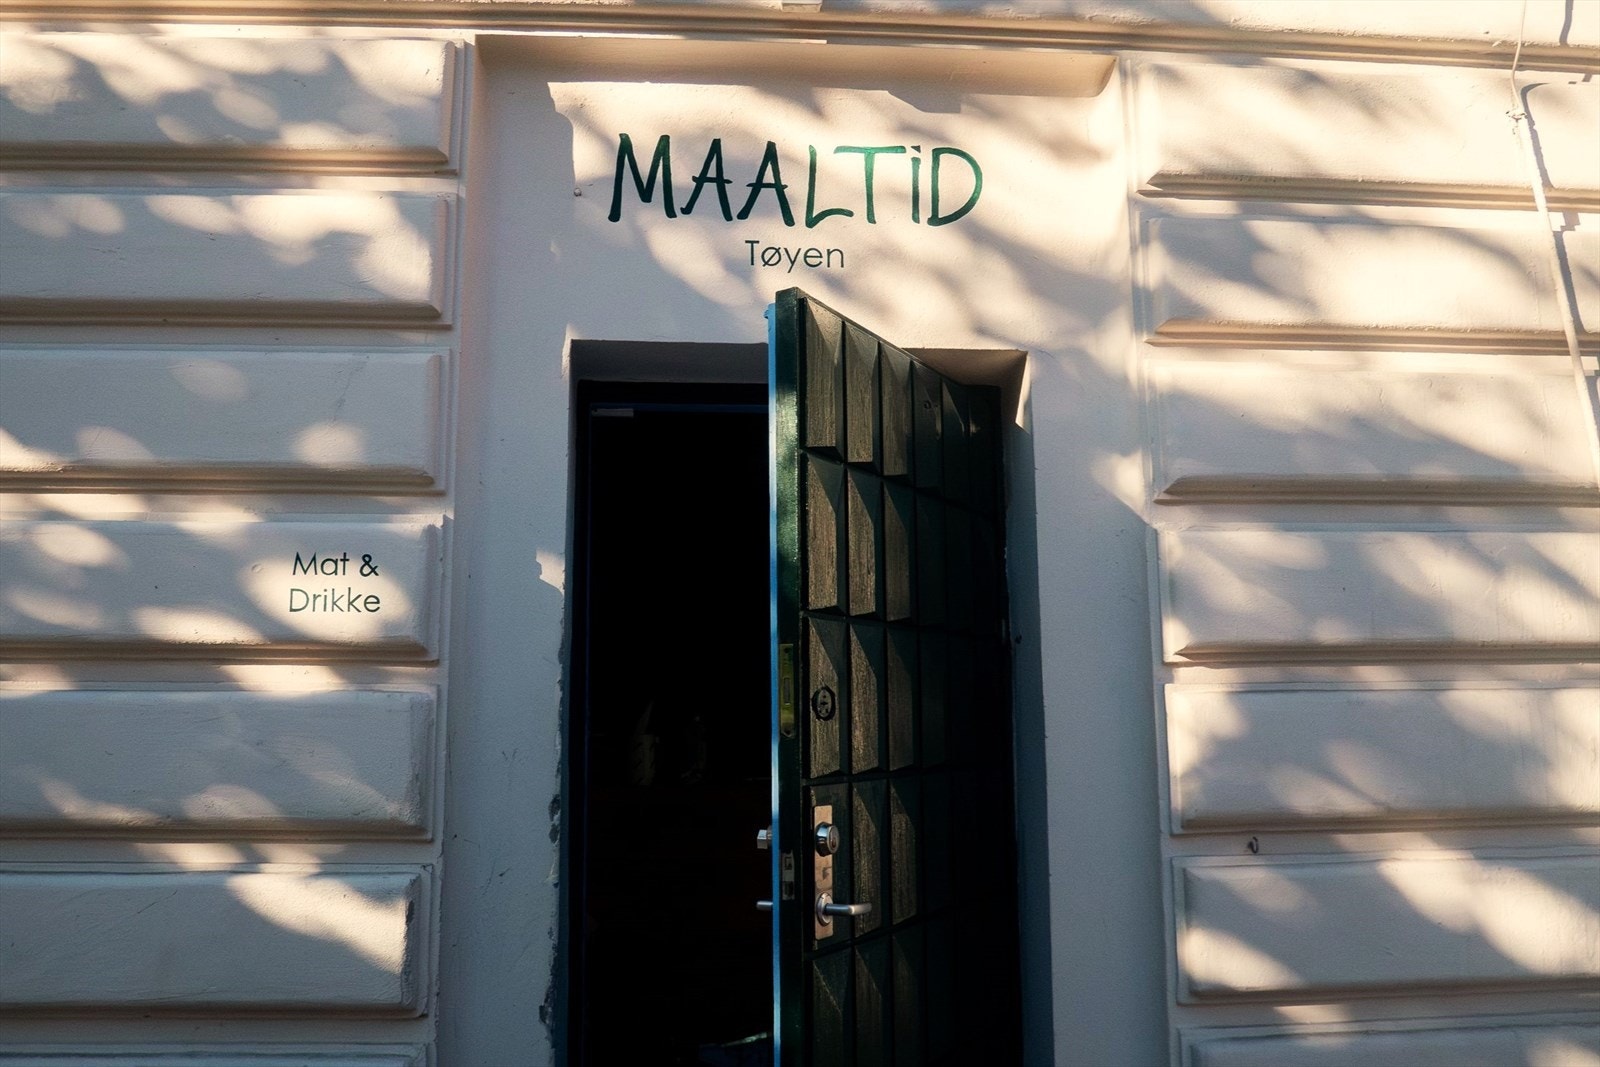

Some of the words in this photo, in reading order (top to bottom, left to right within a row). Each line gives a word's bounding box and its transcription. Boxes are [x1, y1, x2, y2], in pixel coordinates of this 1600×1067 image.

[745, 240, 845, 273] Tøyen
[292, 552, 350, 576] Mat
[359, 553, 379, 577] &
[289, 587, 381, 613] Drikke
